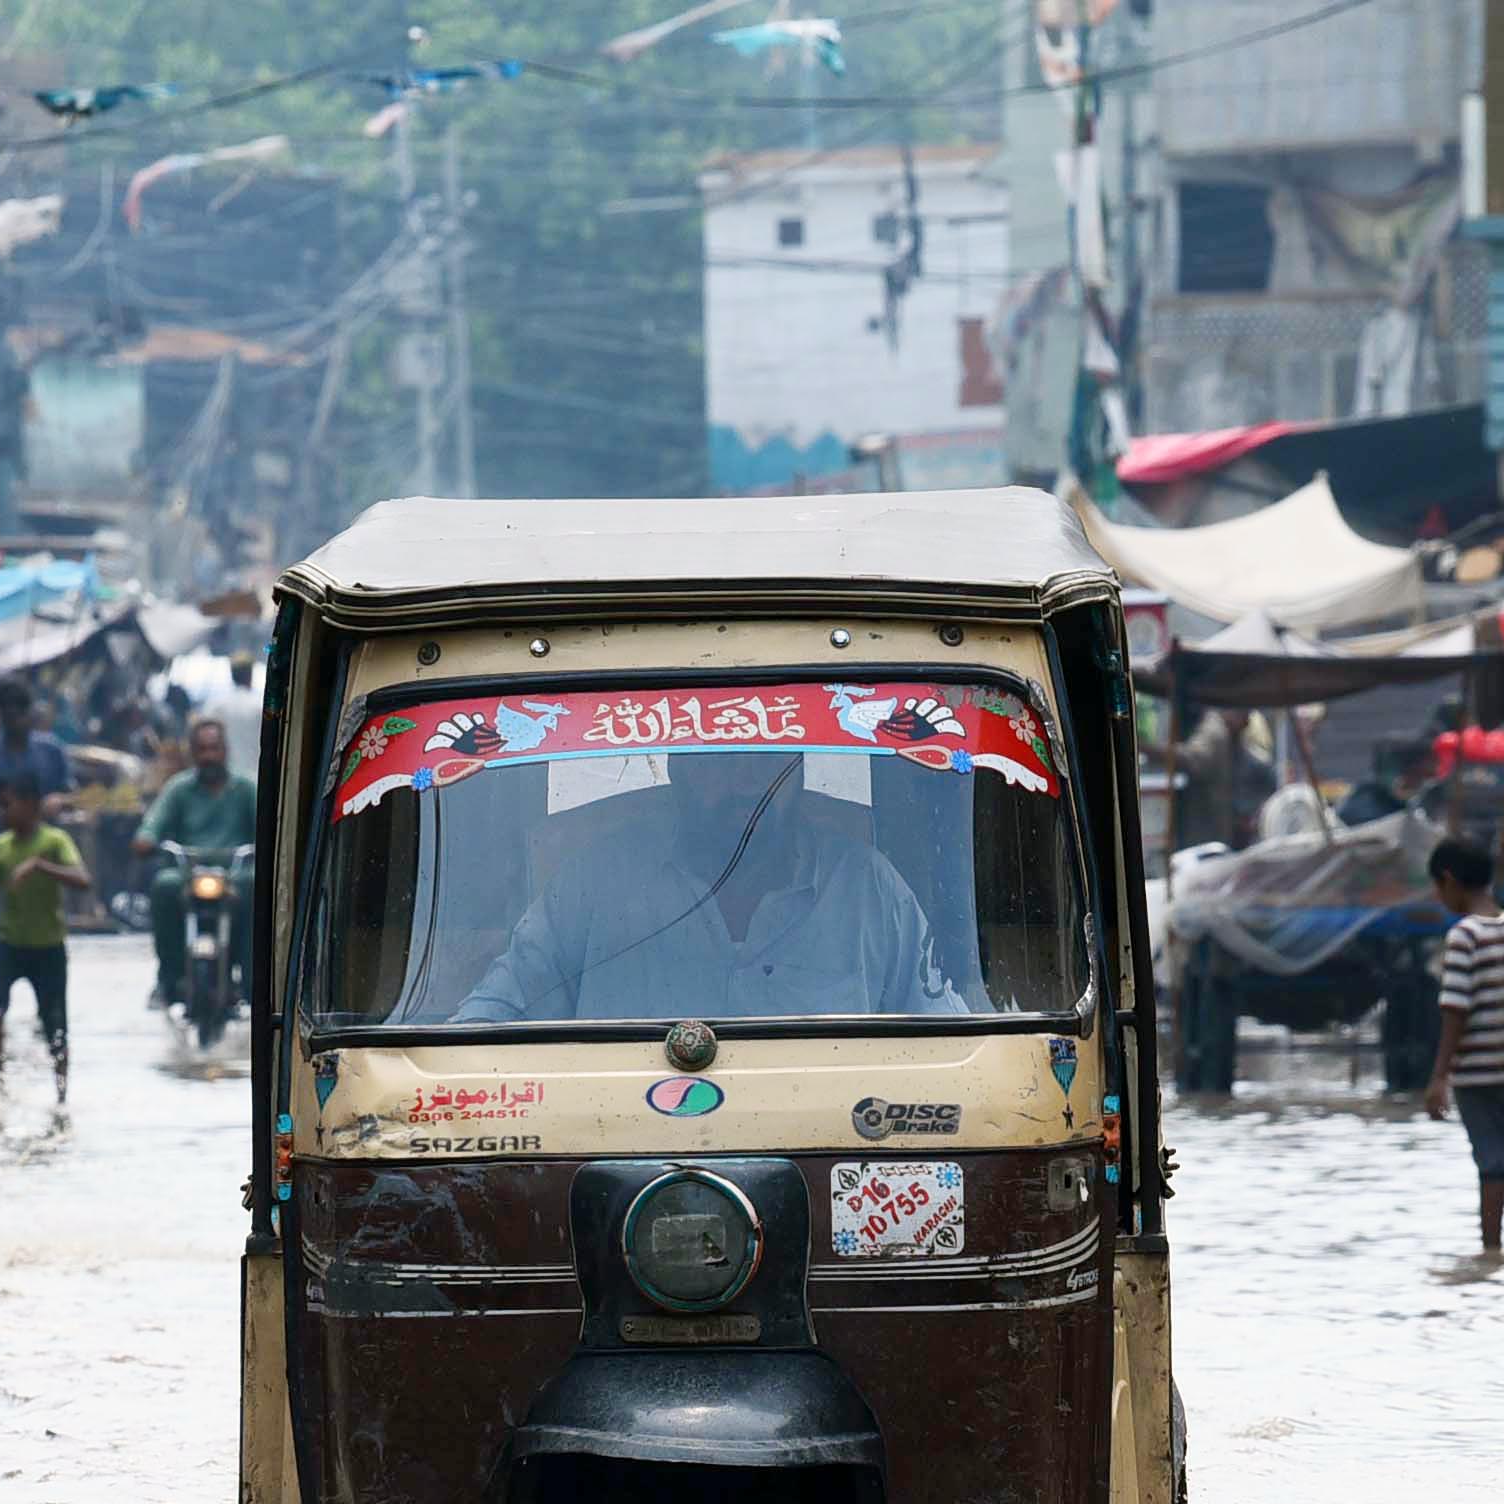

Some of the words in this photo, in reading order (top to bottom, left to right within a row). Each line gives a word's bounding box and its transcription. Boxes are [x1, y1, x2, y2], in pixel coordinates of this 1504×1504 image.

[885, 1103, 957, 1120] DISC
[892, 1119, 955, 1133] Brake
[408, 1135, 542, 1153] SAZGAR
